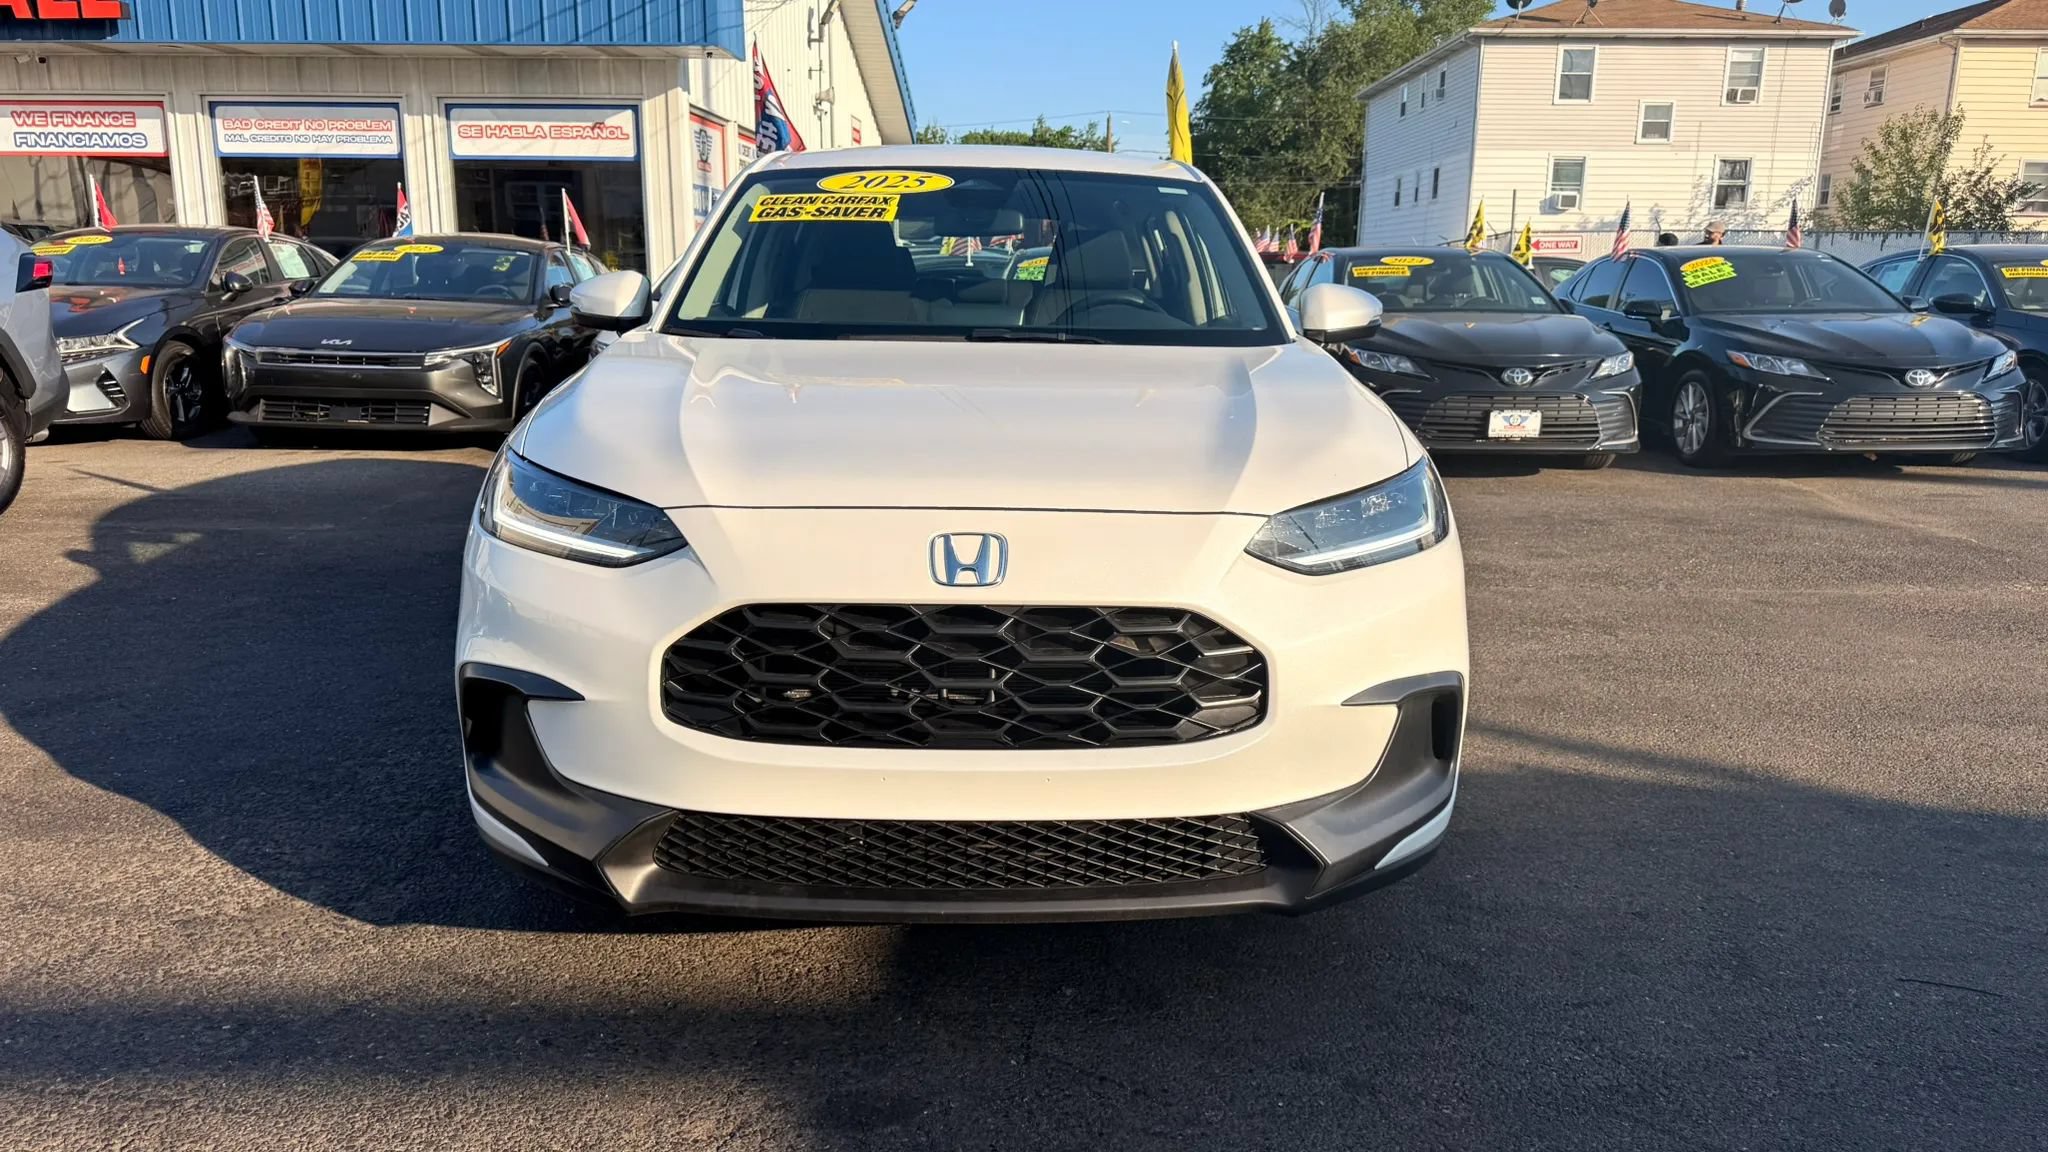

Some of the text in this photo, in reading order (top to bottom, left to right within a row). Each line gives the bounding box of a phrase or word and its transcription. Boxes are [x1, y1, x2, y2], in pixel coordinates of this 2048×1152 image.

[11, 110, 136, 128] WE FINANCE
[223, 118, 392, 132] BAD CREDIT NO PROBLEM
[458, 122, 629, 139] SE HABLA ESPAÑOL
[14, 131, 148, 148] FINANCIAMOS
[224, 134, 393, 144] MAL CREDITO NO HAY PROBLEMA
[840, 175, 933, 189] 2025
[759, 195, 894, 206] CLEAN CARFAX
[756, 206, 888, 219] GAS-SAVER
[1539, 241, 1577, 249] ONE WAY
[1691, 267, 1724, 280] SALE
